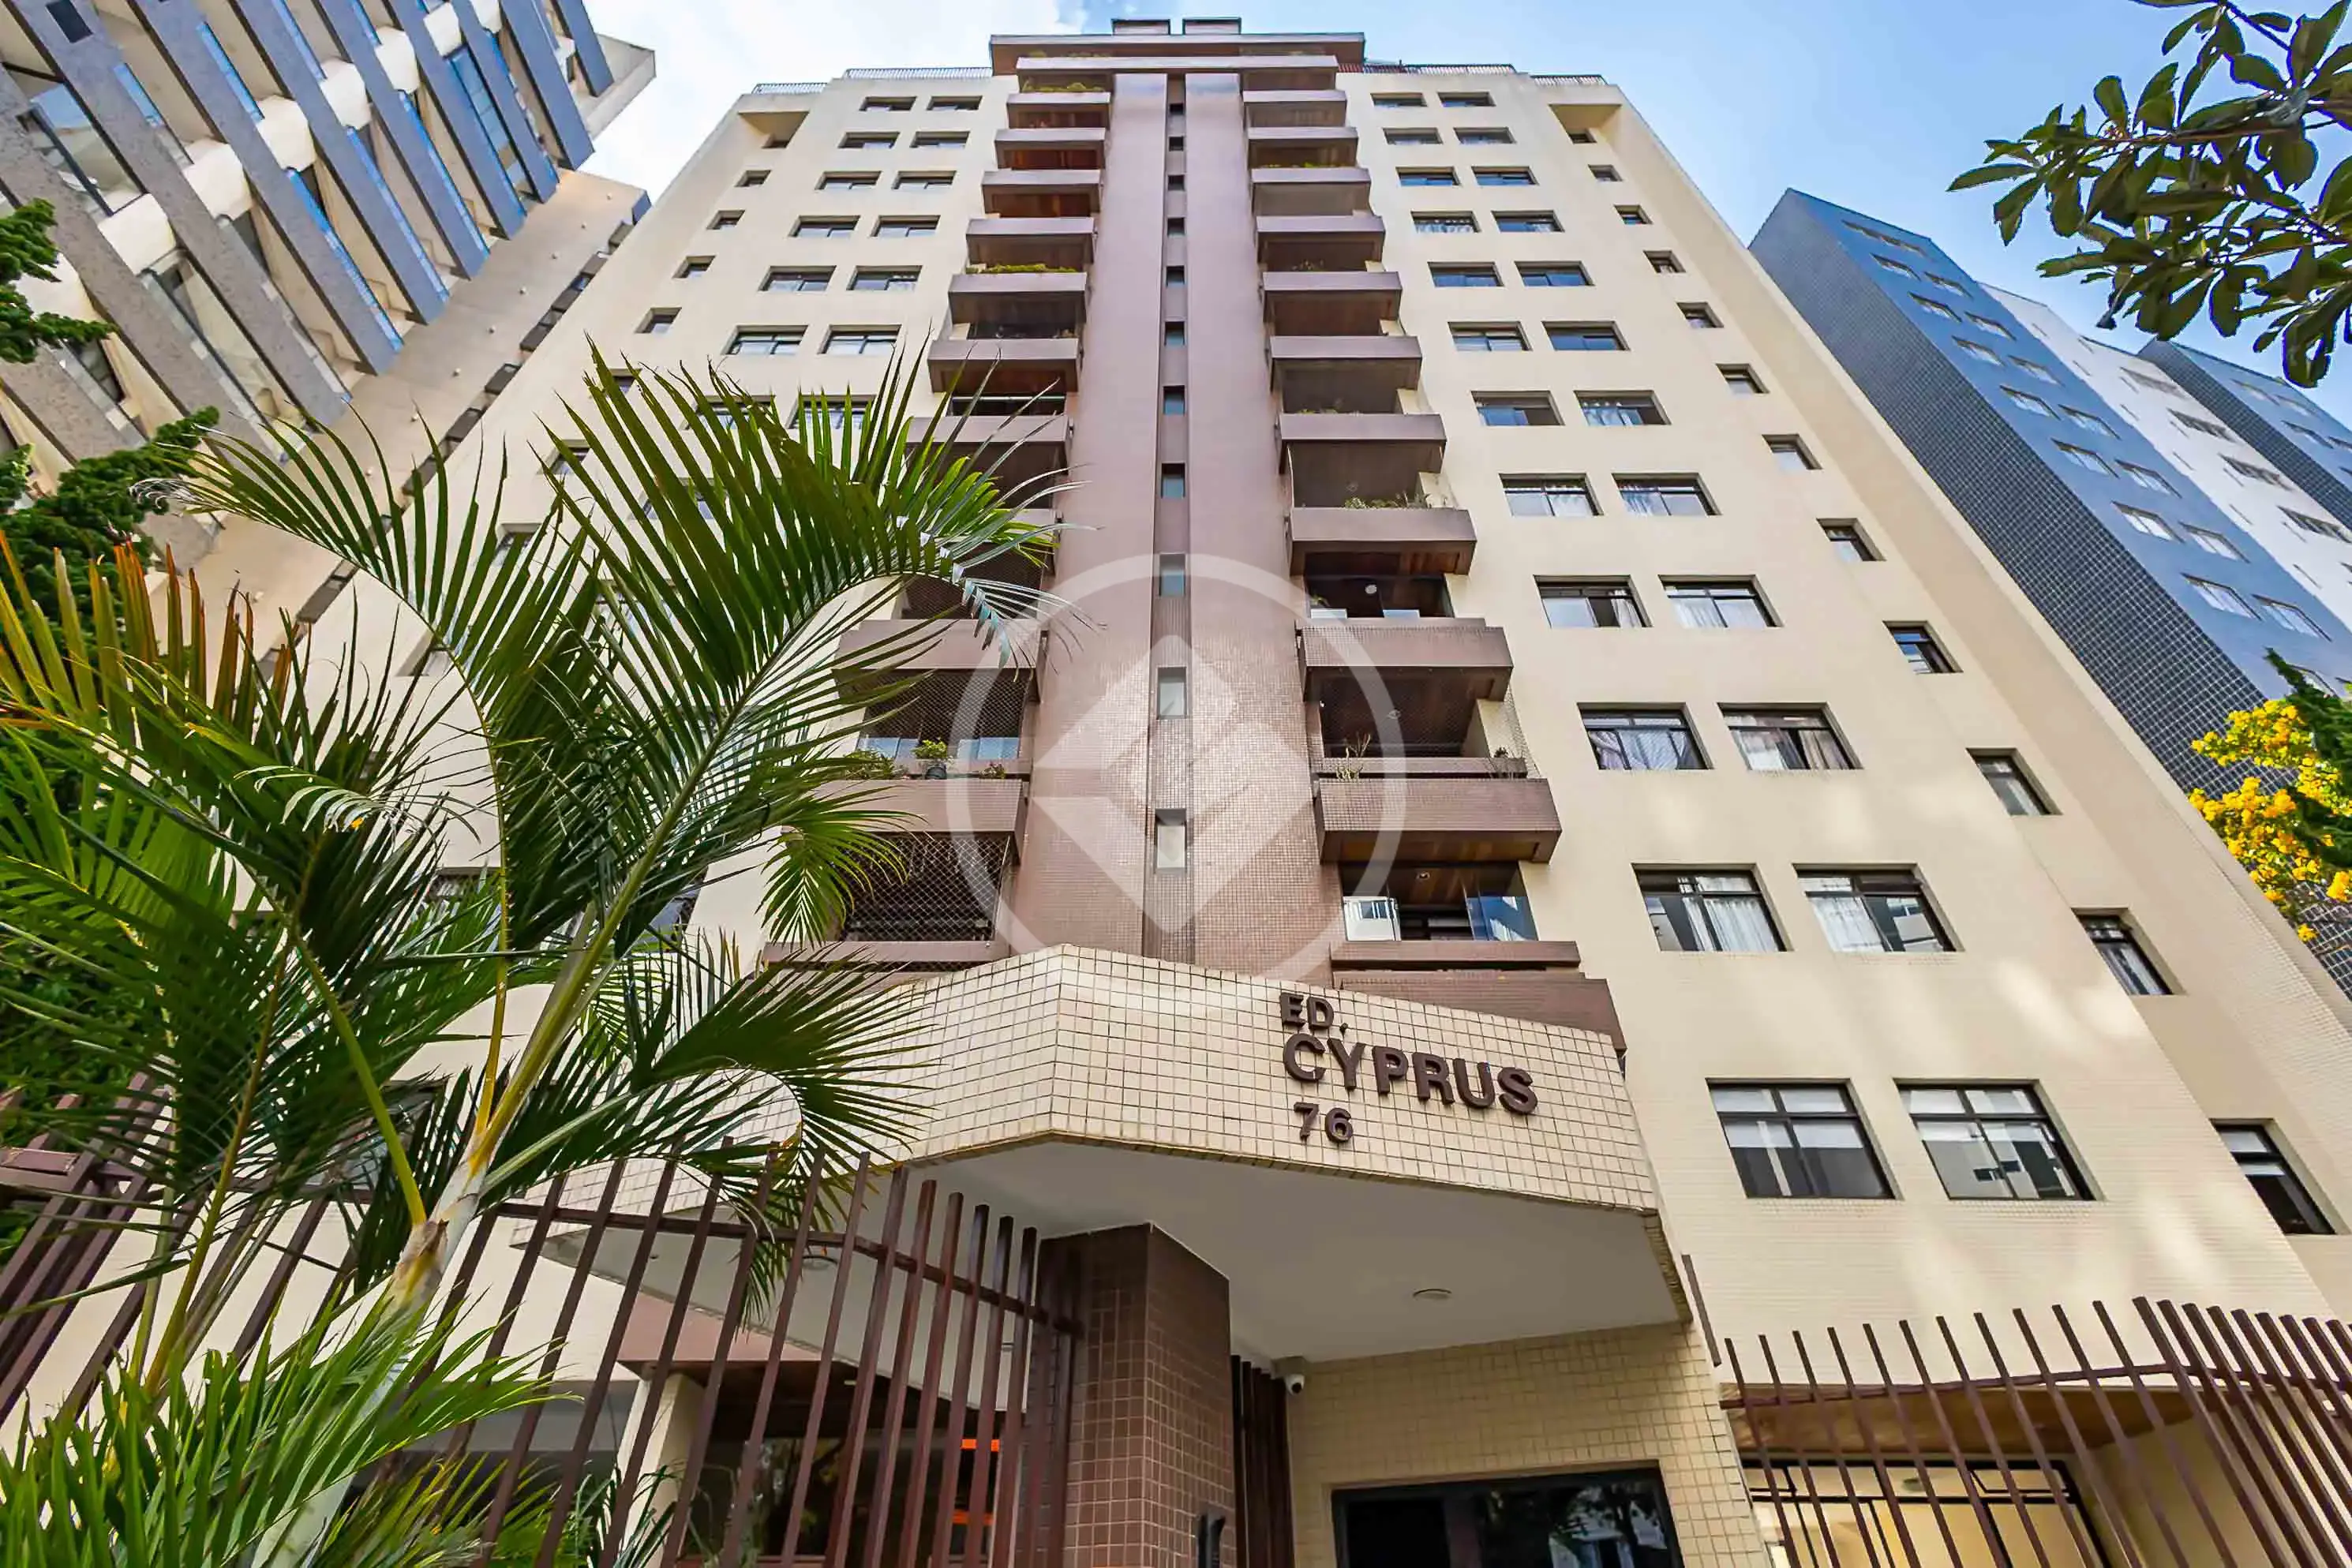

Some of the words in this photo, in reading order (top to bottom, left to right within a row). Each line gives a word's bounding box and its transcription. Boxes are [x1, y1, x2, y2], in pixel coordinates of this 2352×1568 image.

[1279, 992, 1348, 1033] ED.
[1283, 1033, 1537, 1115] CYPRUS
[1294, 1102, 1354, 1143] 76
